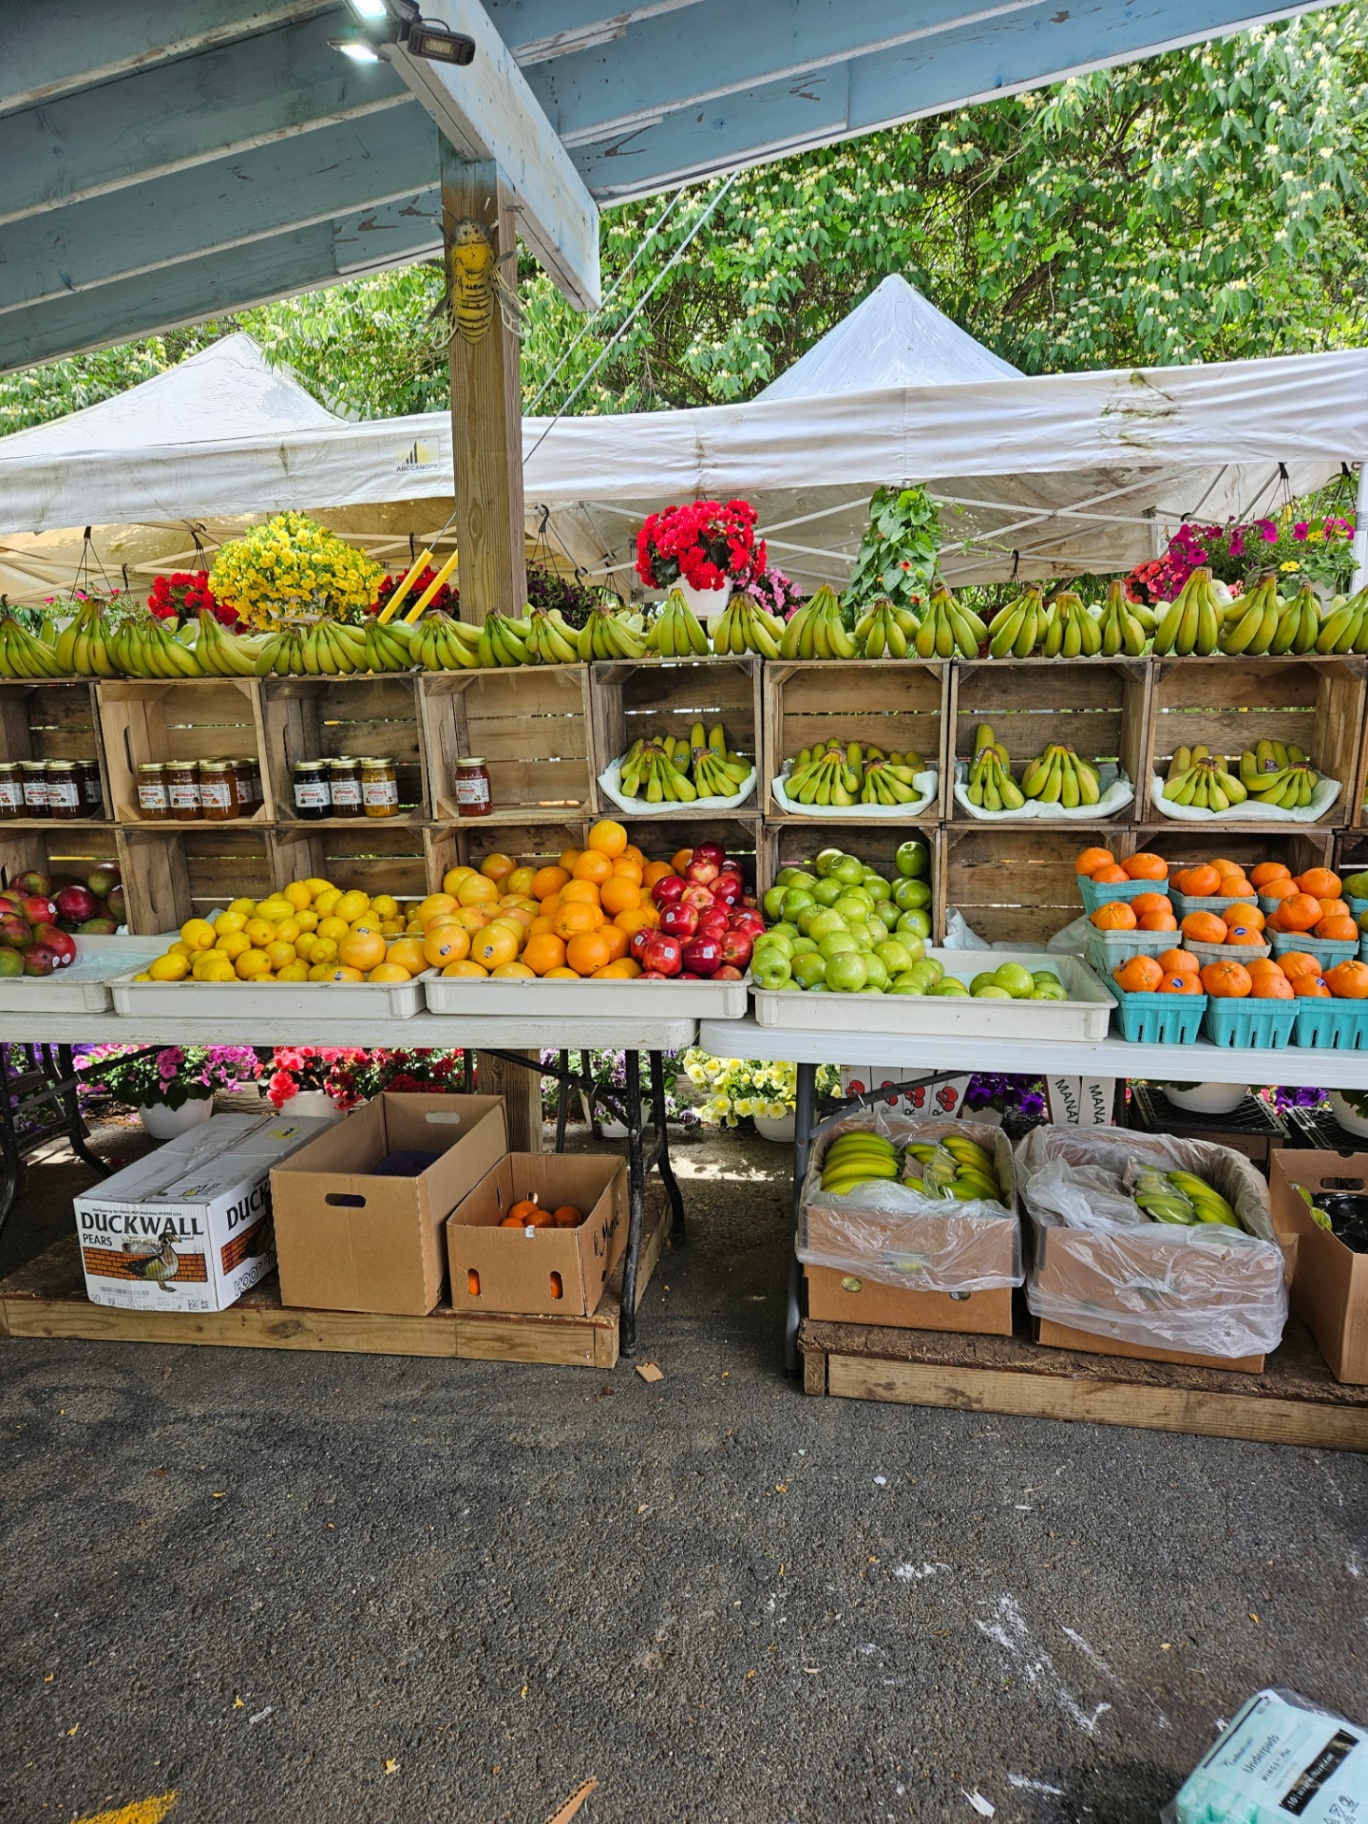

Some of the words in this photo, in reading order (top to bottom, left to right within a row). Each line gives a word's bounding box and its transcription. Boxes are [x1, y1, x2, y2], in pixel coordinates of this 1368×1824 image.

[80, 1212, 204, 1236] DUCKWALL
[82, 1233, 113, 1247] PEARS
[1242, 1734, 1280, 1774] Underpads
